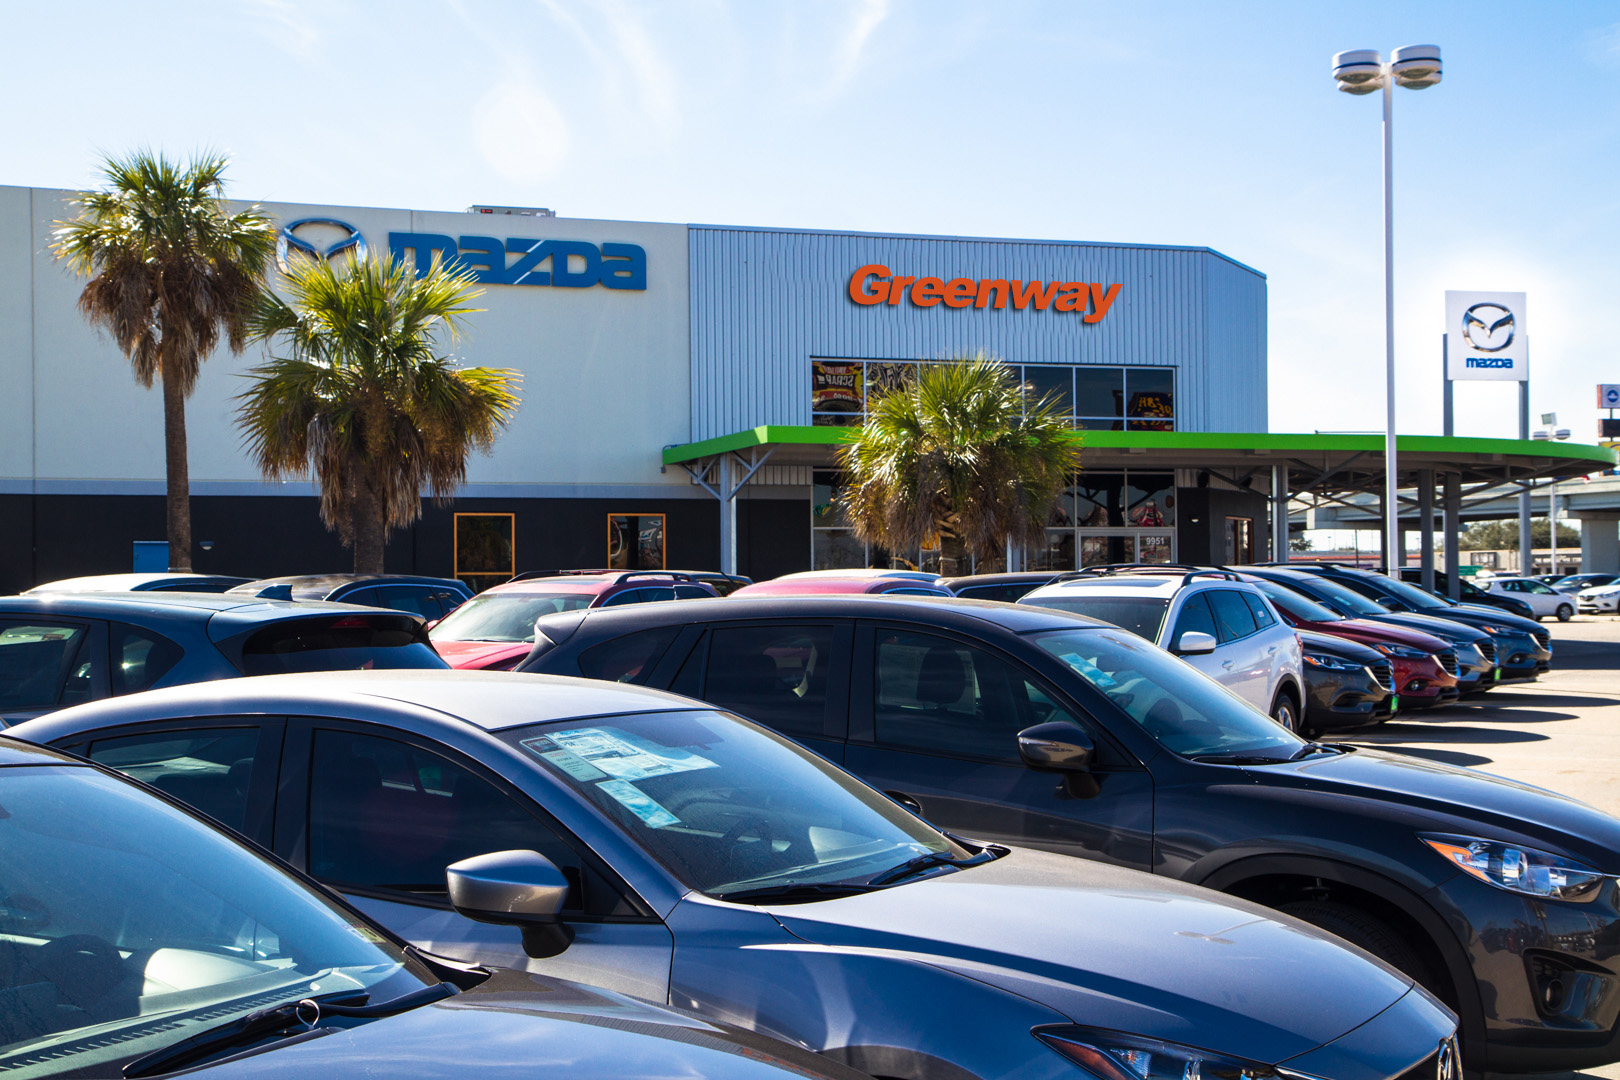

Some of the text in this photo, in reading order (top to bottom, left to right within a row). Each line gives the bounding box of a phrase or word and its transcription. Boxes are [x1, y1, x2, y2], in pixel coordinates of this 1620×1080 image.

[388, 232, 647, 290] mazda
[849, 264, 1123, 324] Greenway
[1466, 357, 1513, 368] mazda
[1146, 536, 1165, 545] 9951
